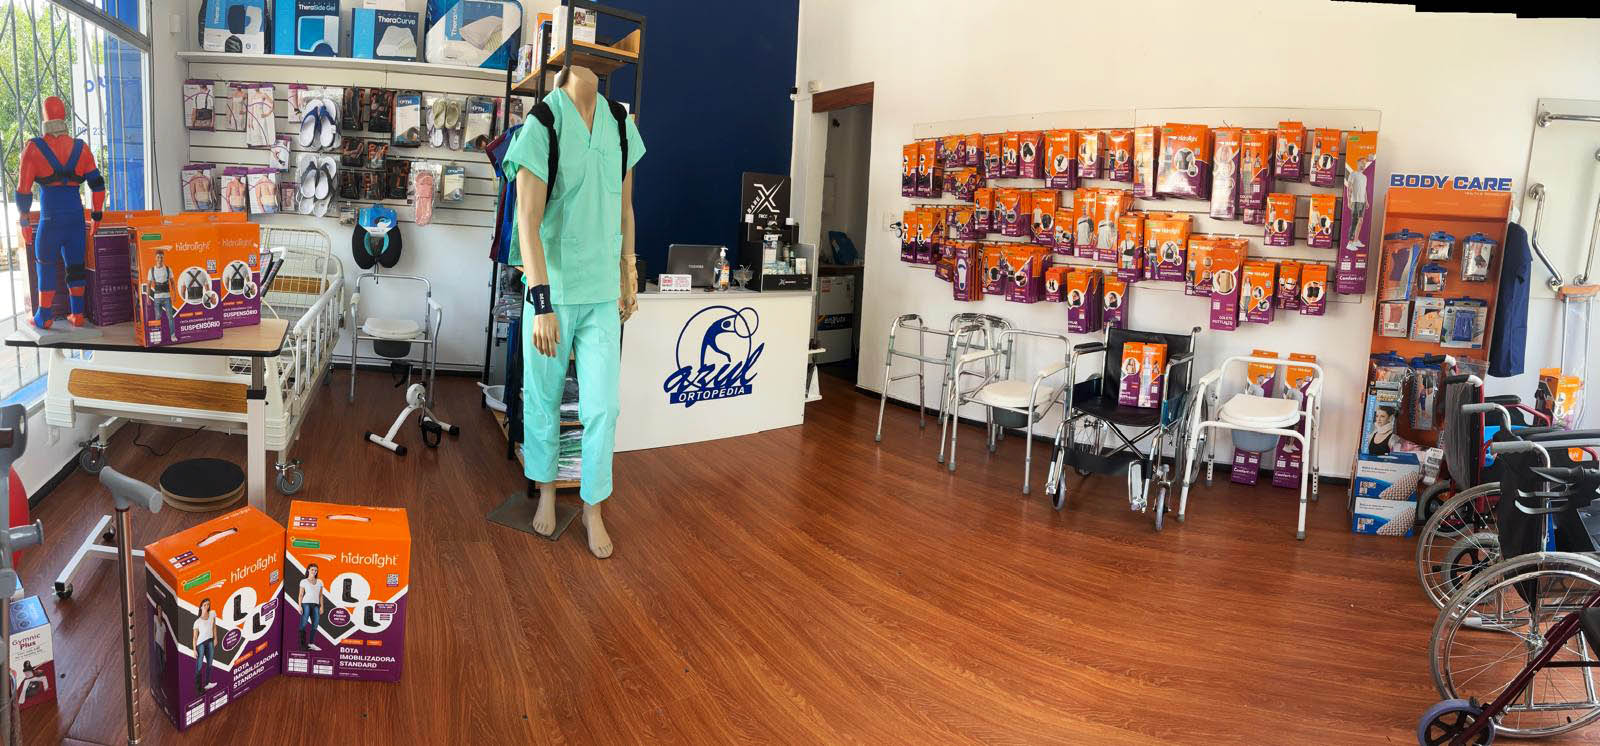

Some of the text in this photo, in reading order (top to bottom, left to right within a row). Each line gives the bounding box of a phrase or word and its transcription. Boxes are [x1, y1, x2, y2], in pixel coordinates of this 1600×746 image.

[377, 15, 416, 25] TheraCurve
[1390, 173, 1512, 191] BODY CARE
[176, 240, 209, 253] hidrolight
[180, 321, 221, 332] SUSPENSÓRIO
[663, 342, 765, 408] azul
[678, 386, 745, 402] ORTOPÉDIA
[341, 552, 398, 568] hidrolight
[230, 553, 277, 584] hidrolight
[12, 633, 41, 646] Gymnic
[340, 654, 395, 662] IMOBILIZADORA
[233, 651, 279, 682] IMOBILIZADORA
[233, 662, 250, 675] BOTA
[233, 666, 265, 689] STANDARD
